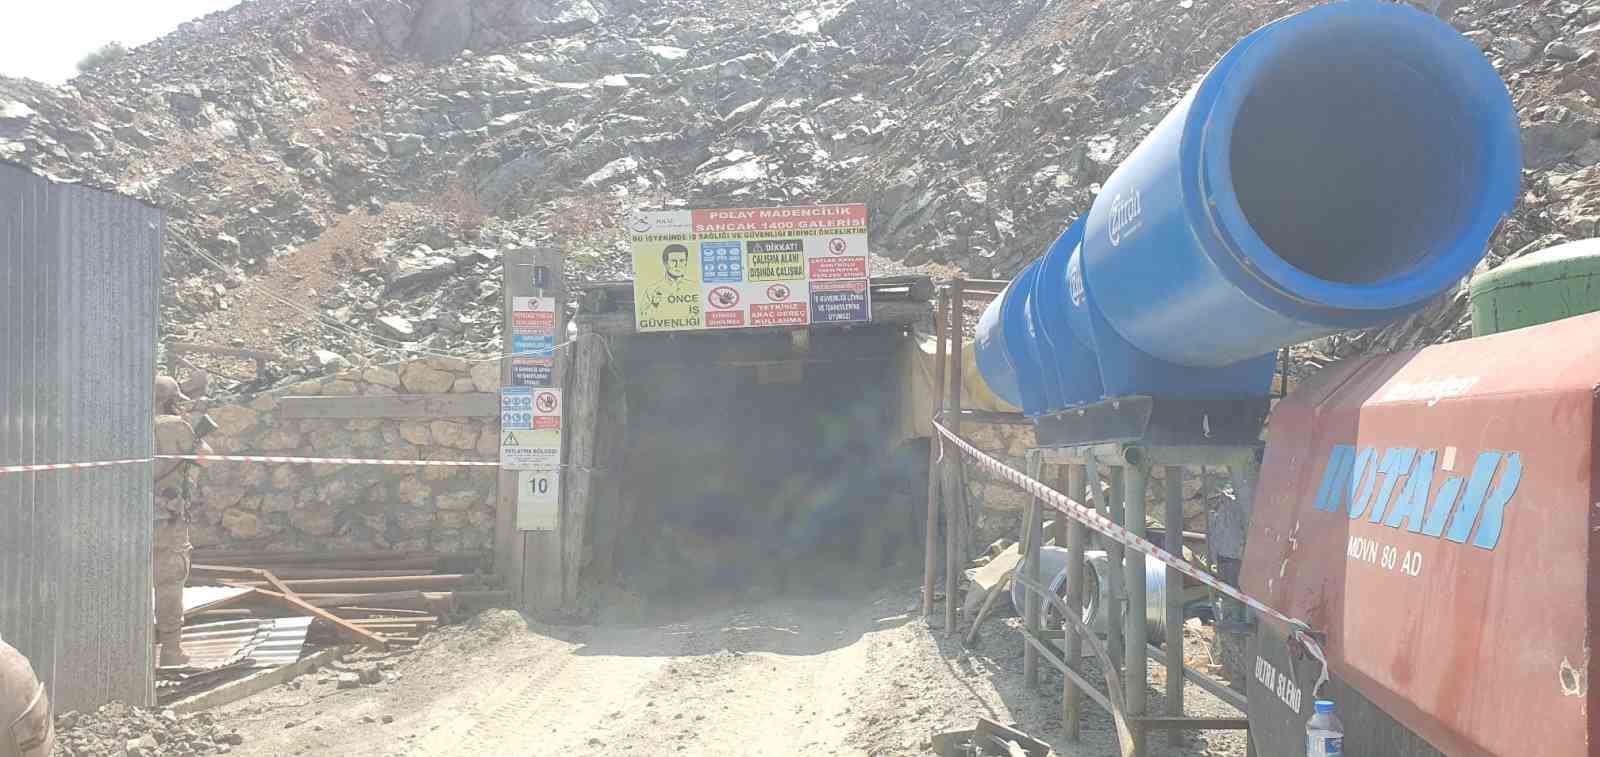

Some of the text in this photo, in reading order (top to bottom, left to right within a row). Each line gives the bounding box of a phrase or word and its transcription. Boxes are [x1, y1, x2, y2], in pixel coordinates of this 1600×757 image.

[709, 211, 753, 220] POLAY
[695, 223, 756, 232] SANCAK
[528, 478, 548, 494] 10
[1347, 535, 1423, 577] MDVN 80 AD
[1255, 655, 1276, 692] ULTRA
